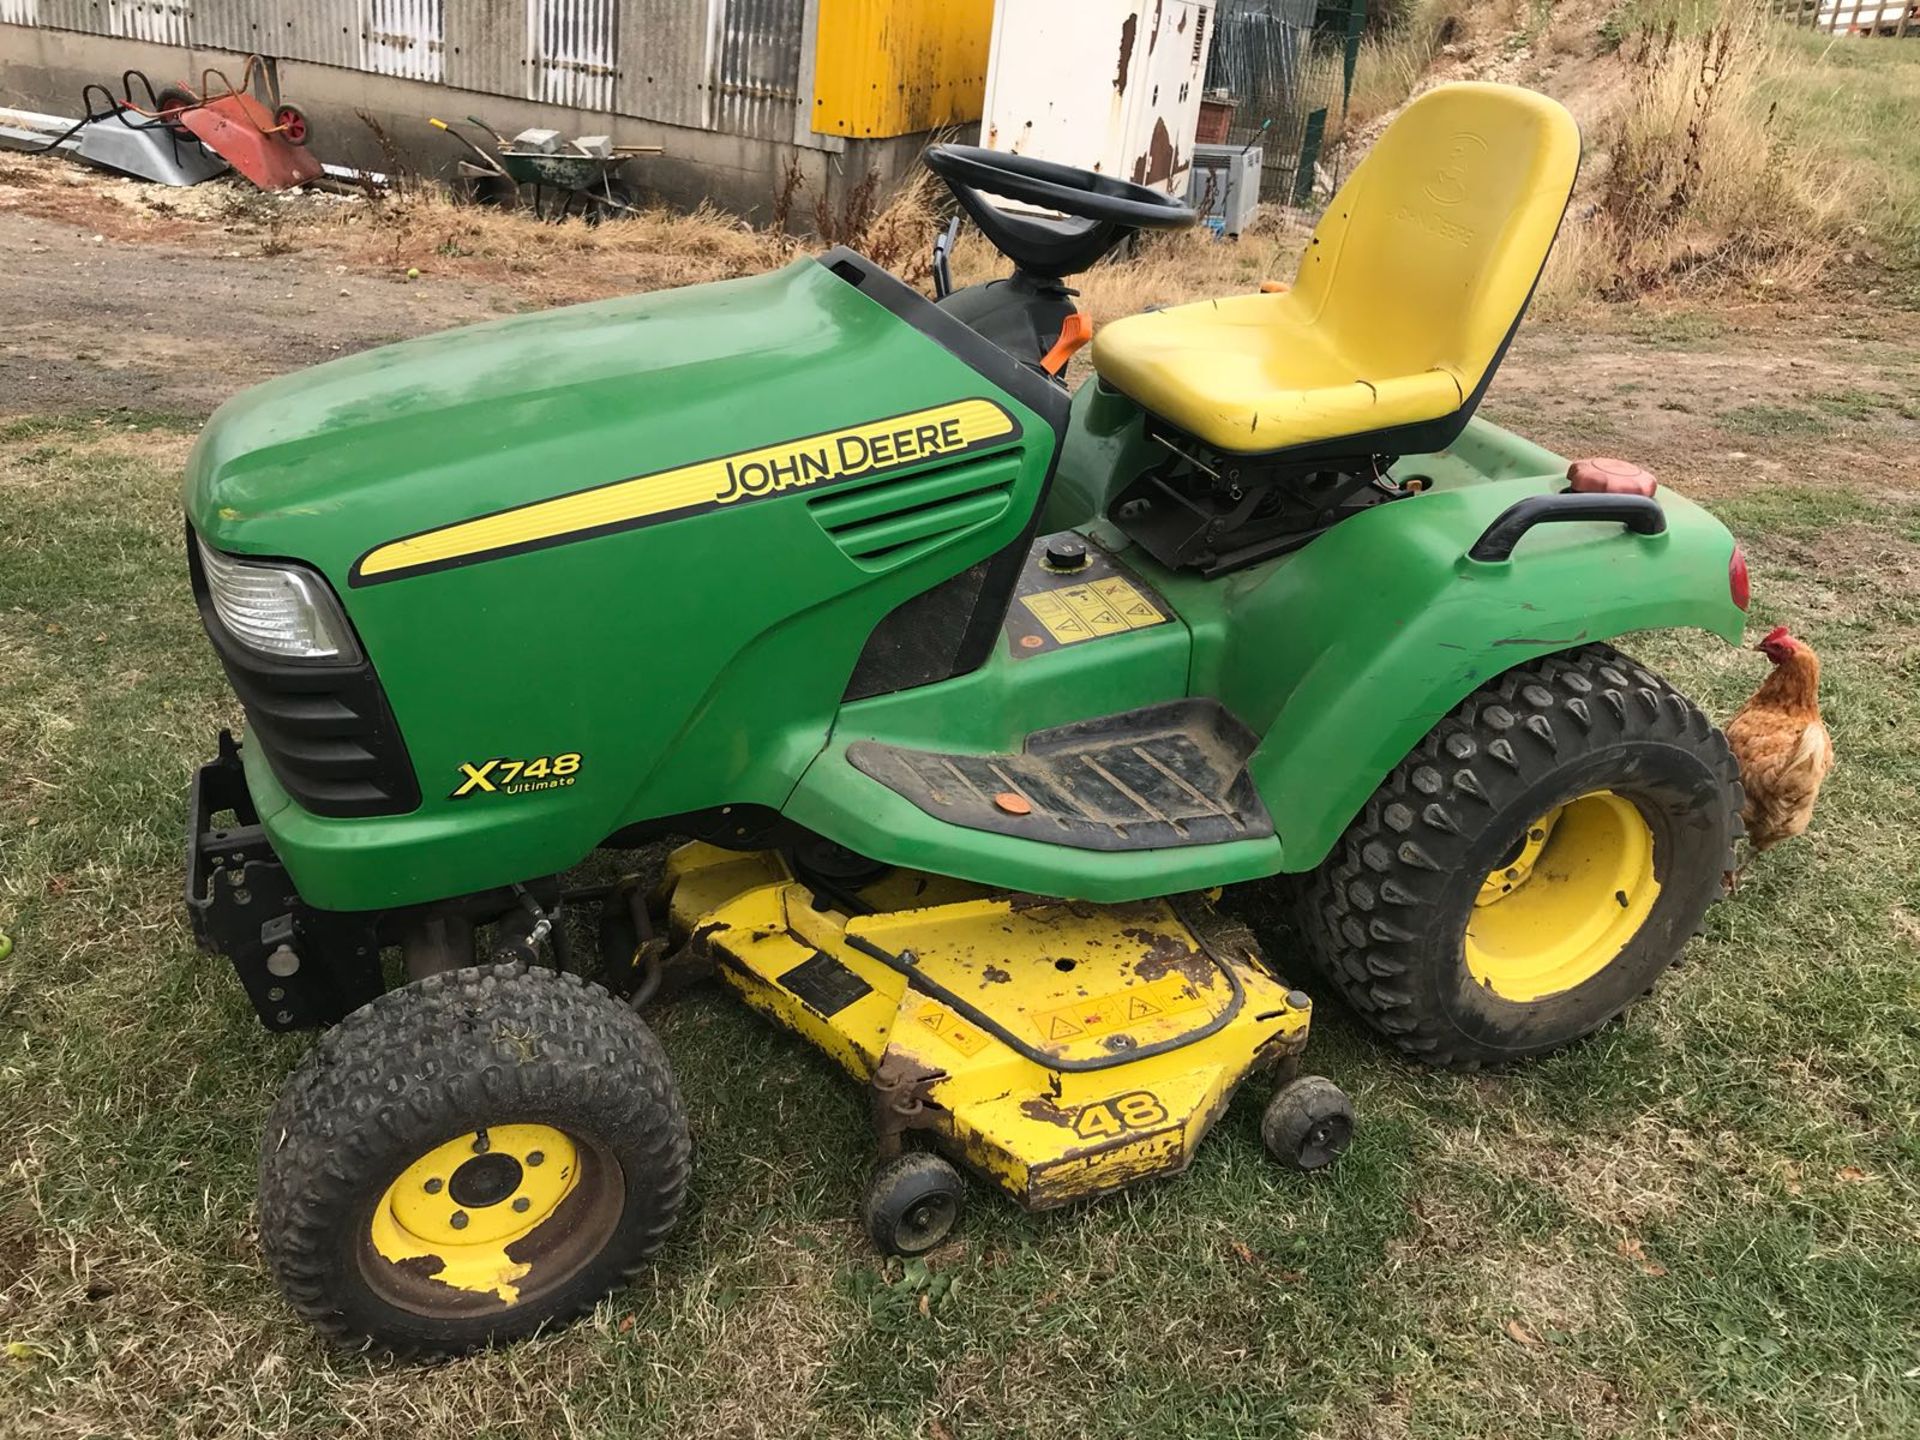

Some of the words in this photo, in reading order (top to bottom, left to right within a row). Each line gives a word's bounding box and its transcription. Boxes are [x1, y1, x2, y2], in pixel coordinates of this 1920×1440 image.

[716, 449, 831, 499] JOHN
[836, 418, 964, 471] DEERE
[451, 752, 583, 797] X748
[506, 777, 576, 795] Ultimate
[1075, 1091, 1166, 1137] 48
